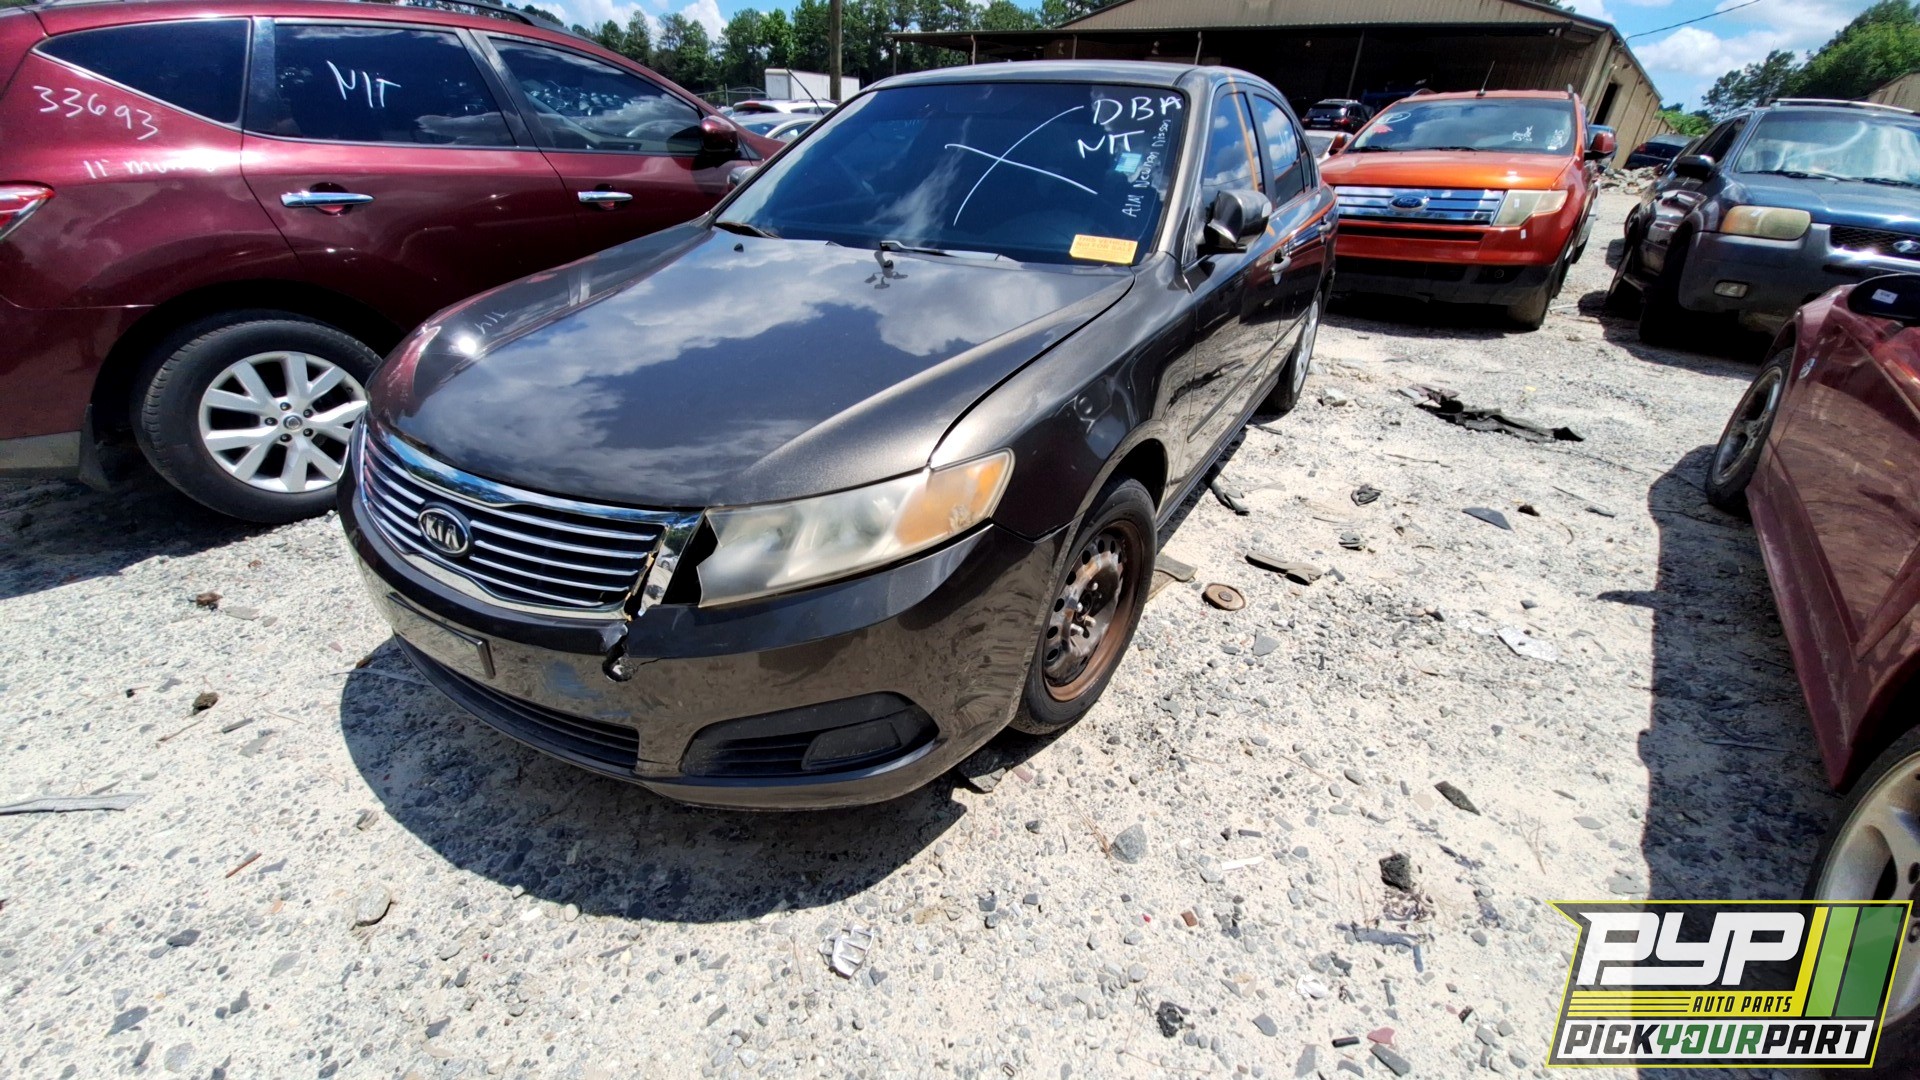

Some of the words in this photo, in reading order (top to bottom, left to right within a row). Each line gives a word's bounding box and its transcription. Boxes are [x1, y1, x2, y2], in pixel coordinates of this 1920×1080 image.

[33, 85, 159, 140] 33693
[1093, 96, 1182, 126] DBA
[423, 514, 460, 550] KIA
